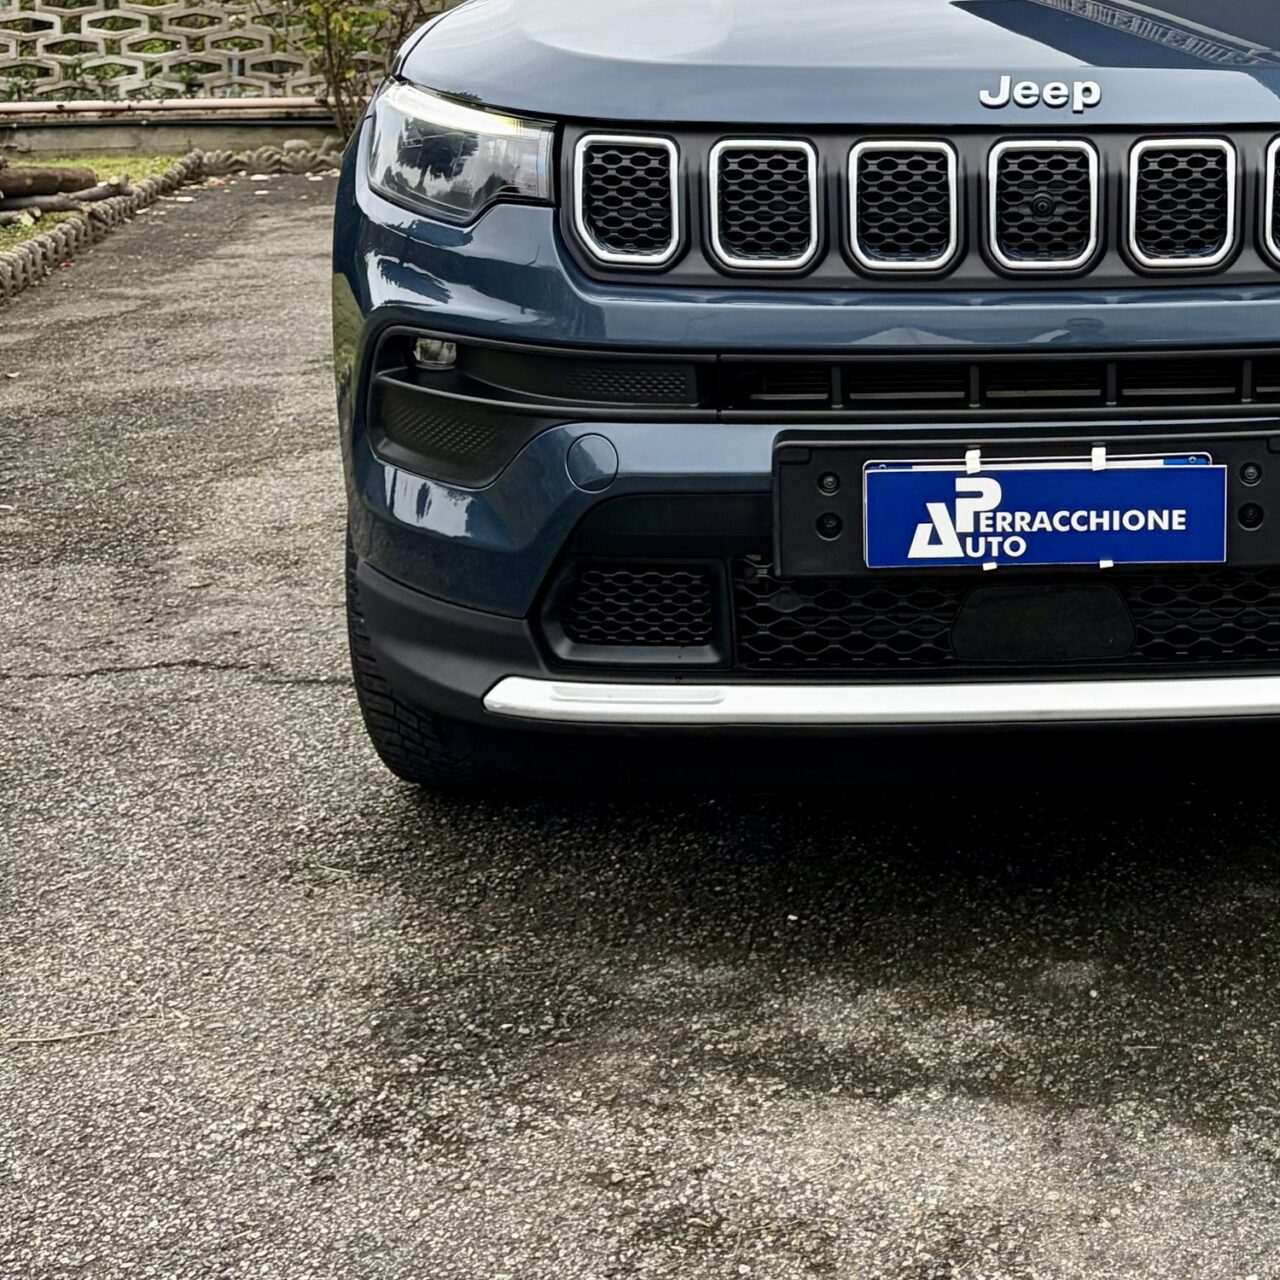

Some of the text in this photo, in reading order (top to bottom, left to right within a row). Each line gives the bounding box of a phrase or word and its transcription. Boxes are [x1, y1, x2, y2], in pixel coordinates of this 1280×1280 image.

[979, 75, 1101, 113] Jeep
[907, 502, 1026, 559] AUTO
[955, 477, 1186, 533] PERRACCHIONE
